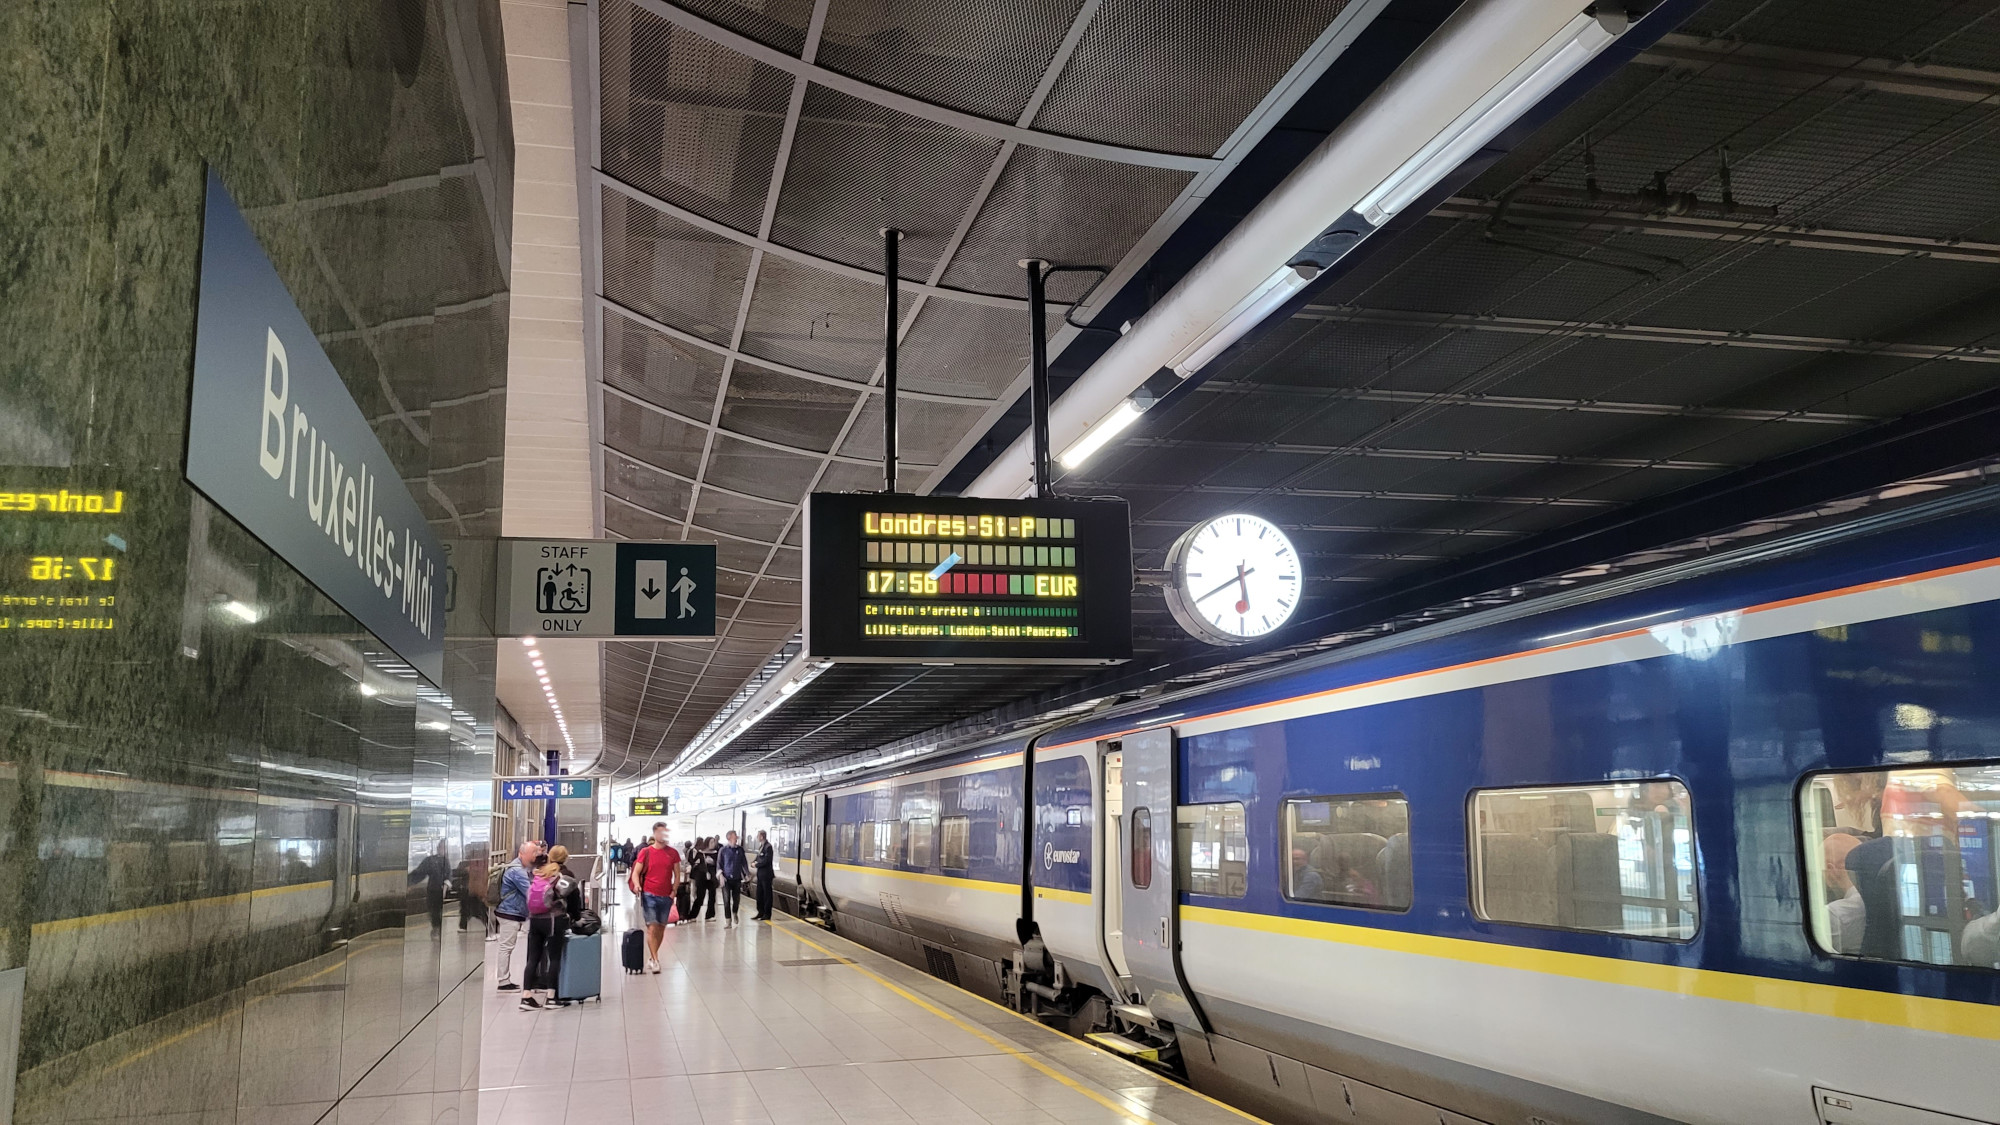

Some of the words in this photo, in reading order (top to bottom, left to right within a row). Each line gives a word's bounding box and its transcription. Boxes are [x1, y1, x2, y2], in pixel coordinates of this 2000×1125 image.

[260, 326, 434, 640] Bruxelles-Midi
[865, 512, 1035, 538] Londres-St-P
[541, 546, 589, 559] STAFF
[868, 572, 938, 594] 17:56
[1036, 575, 1077, 597] EUR
[865, 604, 878, 615] Ce
[885, 605, 914, 616] train
[974, 606, 980, 617] à
[542, 619, 583, 631] ONLY
[1053, 848, 1080, 864] eurostar
